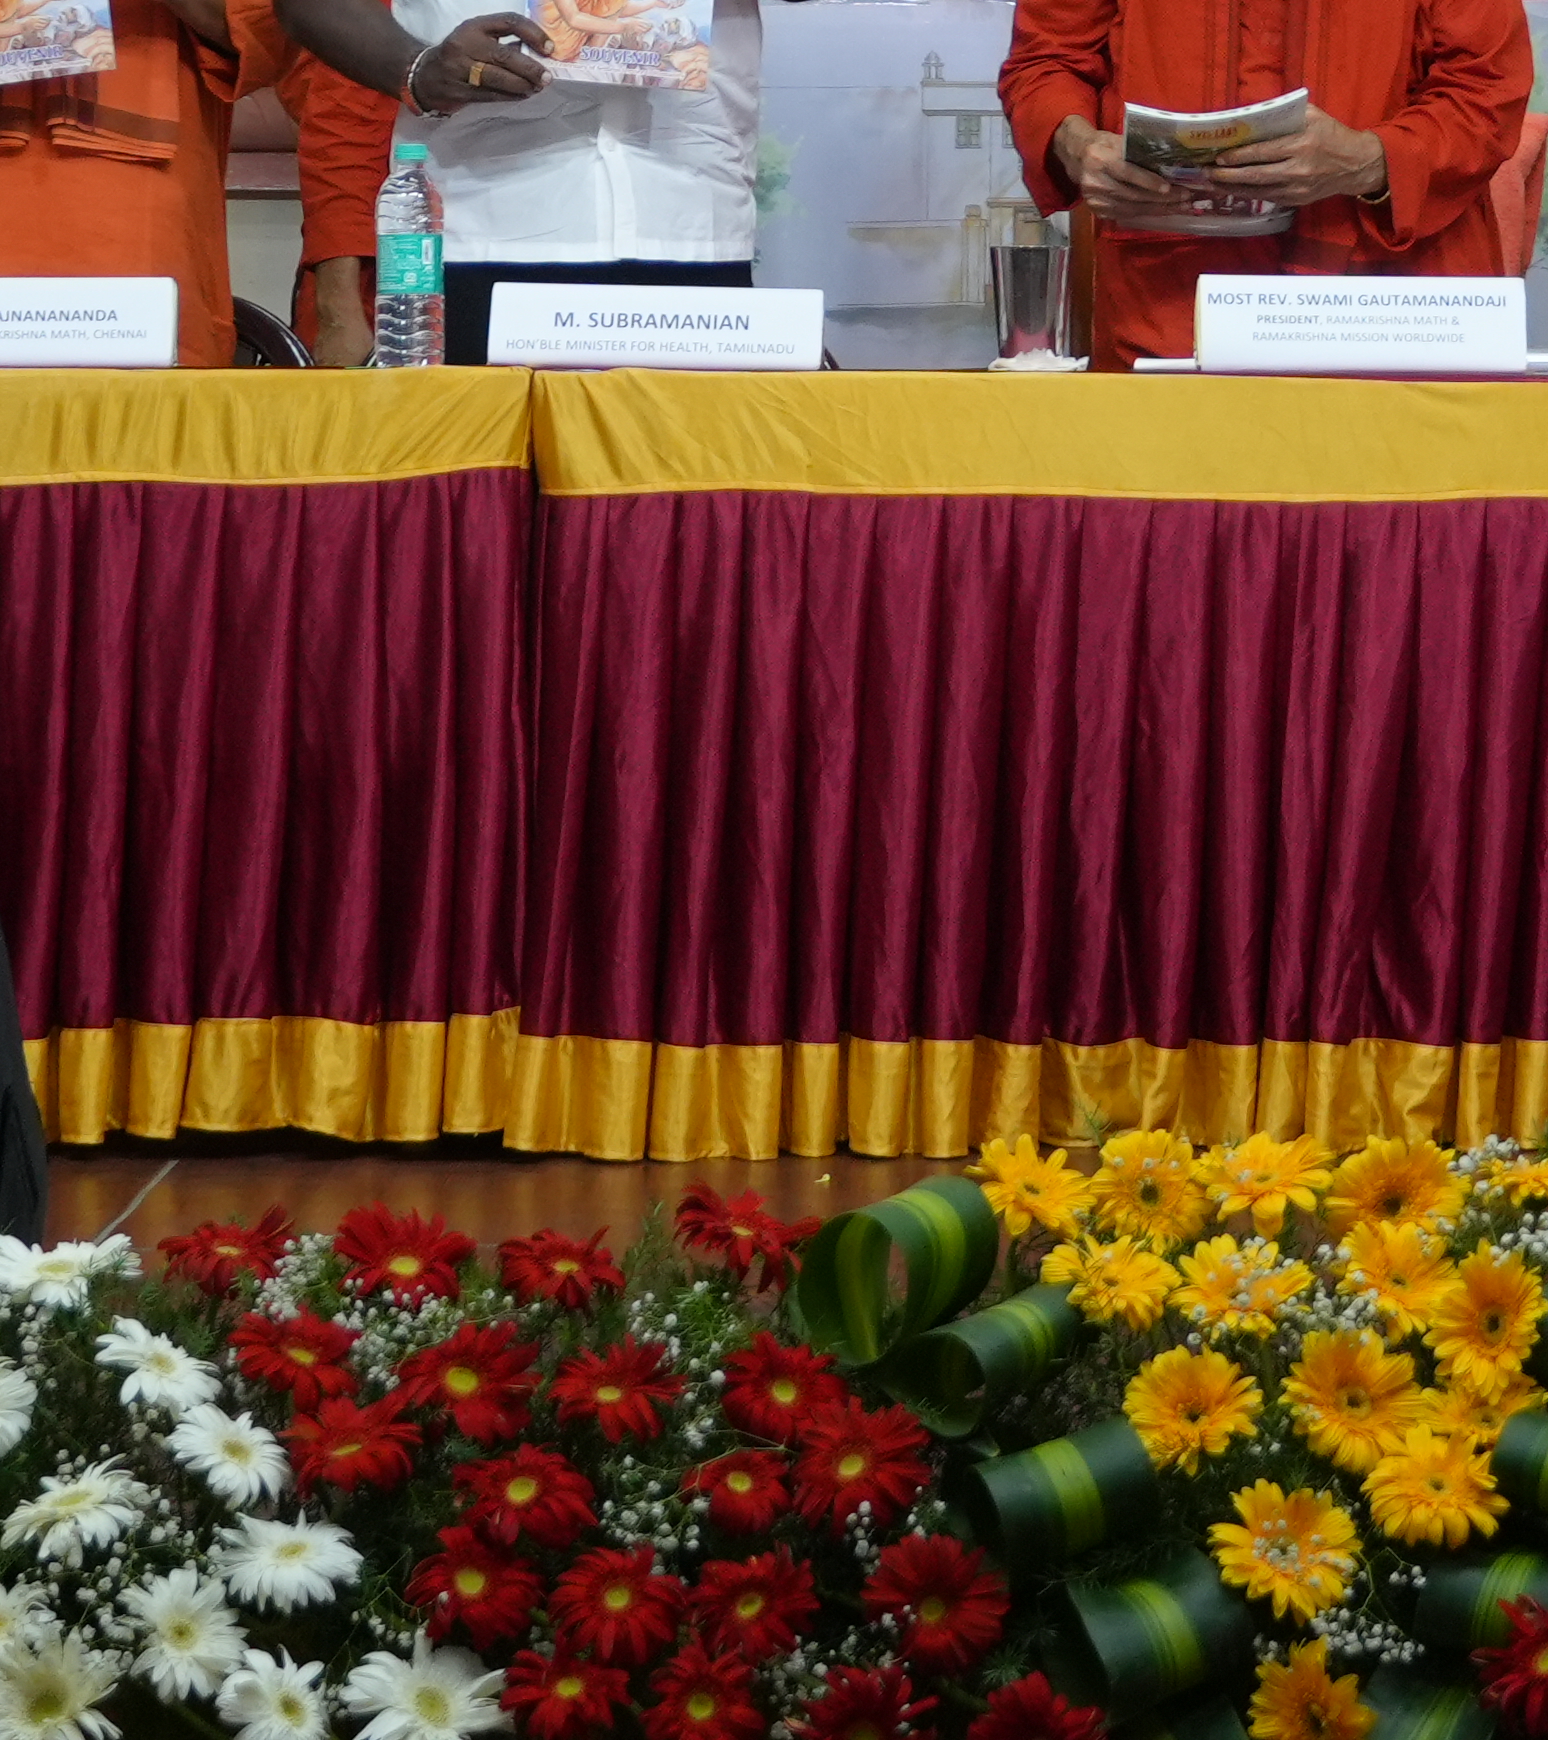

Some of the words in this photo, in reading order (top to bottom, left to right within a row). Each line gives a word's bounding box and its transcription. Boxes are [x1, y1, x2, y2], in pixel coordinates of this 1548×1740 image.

[1207, 293, 1252, 305] MOST
[1258, 293, 1292, 305] REV.
[1296, 293, 1353, 306] SWAMI
[1357, 294, 1507, 307] GAUTAMANANDAJI
[554, 311, 580, 328] M.
[587, 312, 750, 330] SUBRAMANIAN
[1256, 314, 1323, 326] PRESIDENT,
[1326, 314, 1410, 325] RAMAKRISHNA
[1413, 315, 1448, 326] MATH
[1451, 316, 1460, 326] &
[51, 329, 89, 340] MATH,
[93, 329, 147, 339] CHENNAI
[1252, 331, 1337, 342] RAMAKRISHNA
[1340, 331, 1389, 343] MISSION
[1392, 332, 1465, 343] WORLDWIDE
[565, 339, 626, 352] MINISTER
[630, 340, 655, 352] FOR
[659, 341, 712, 355] HEALTH,
[716, 342, 795, 355] TAMILNADU
